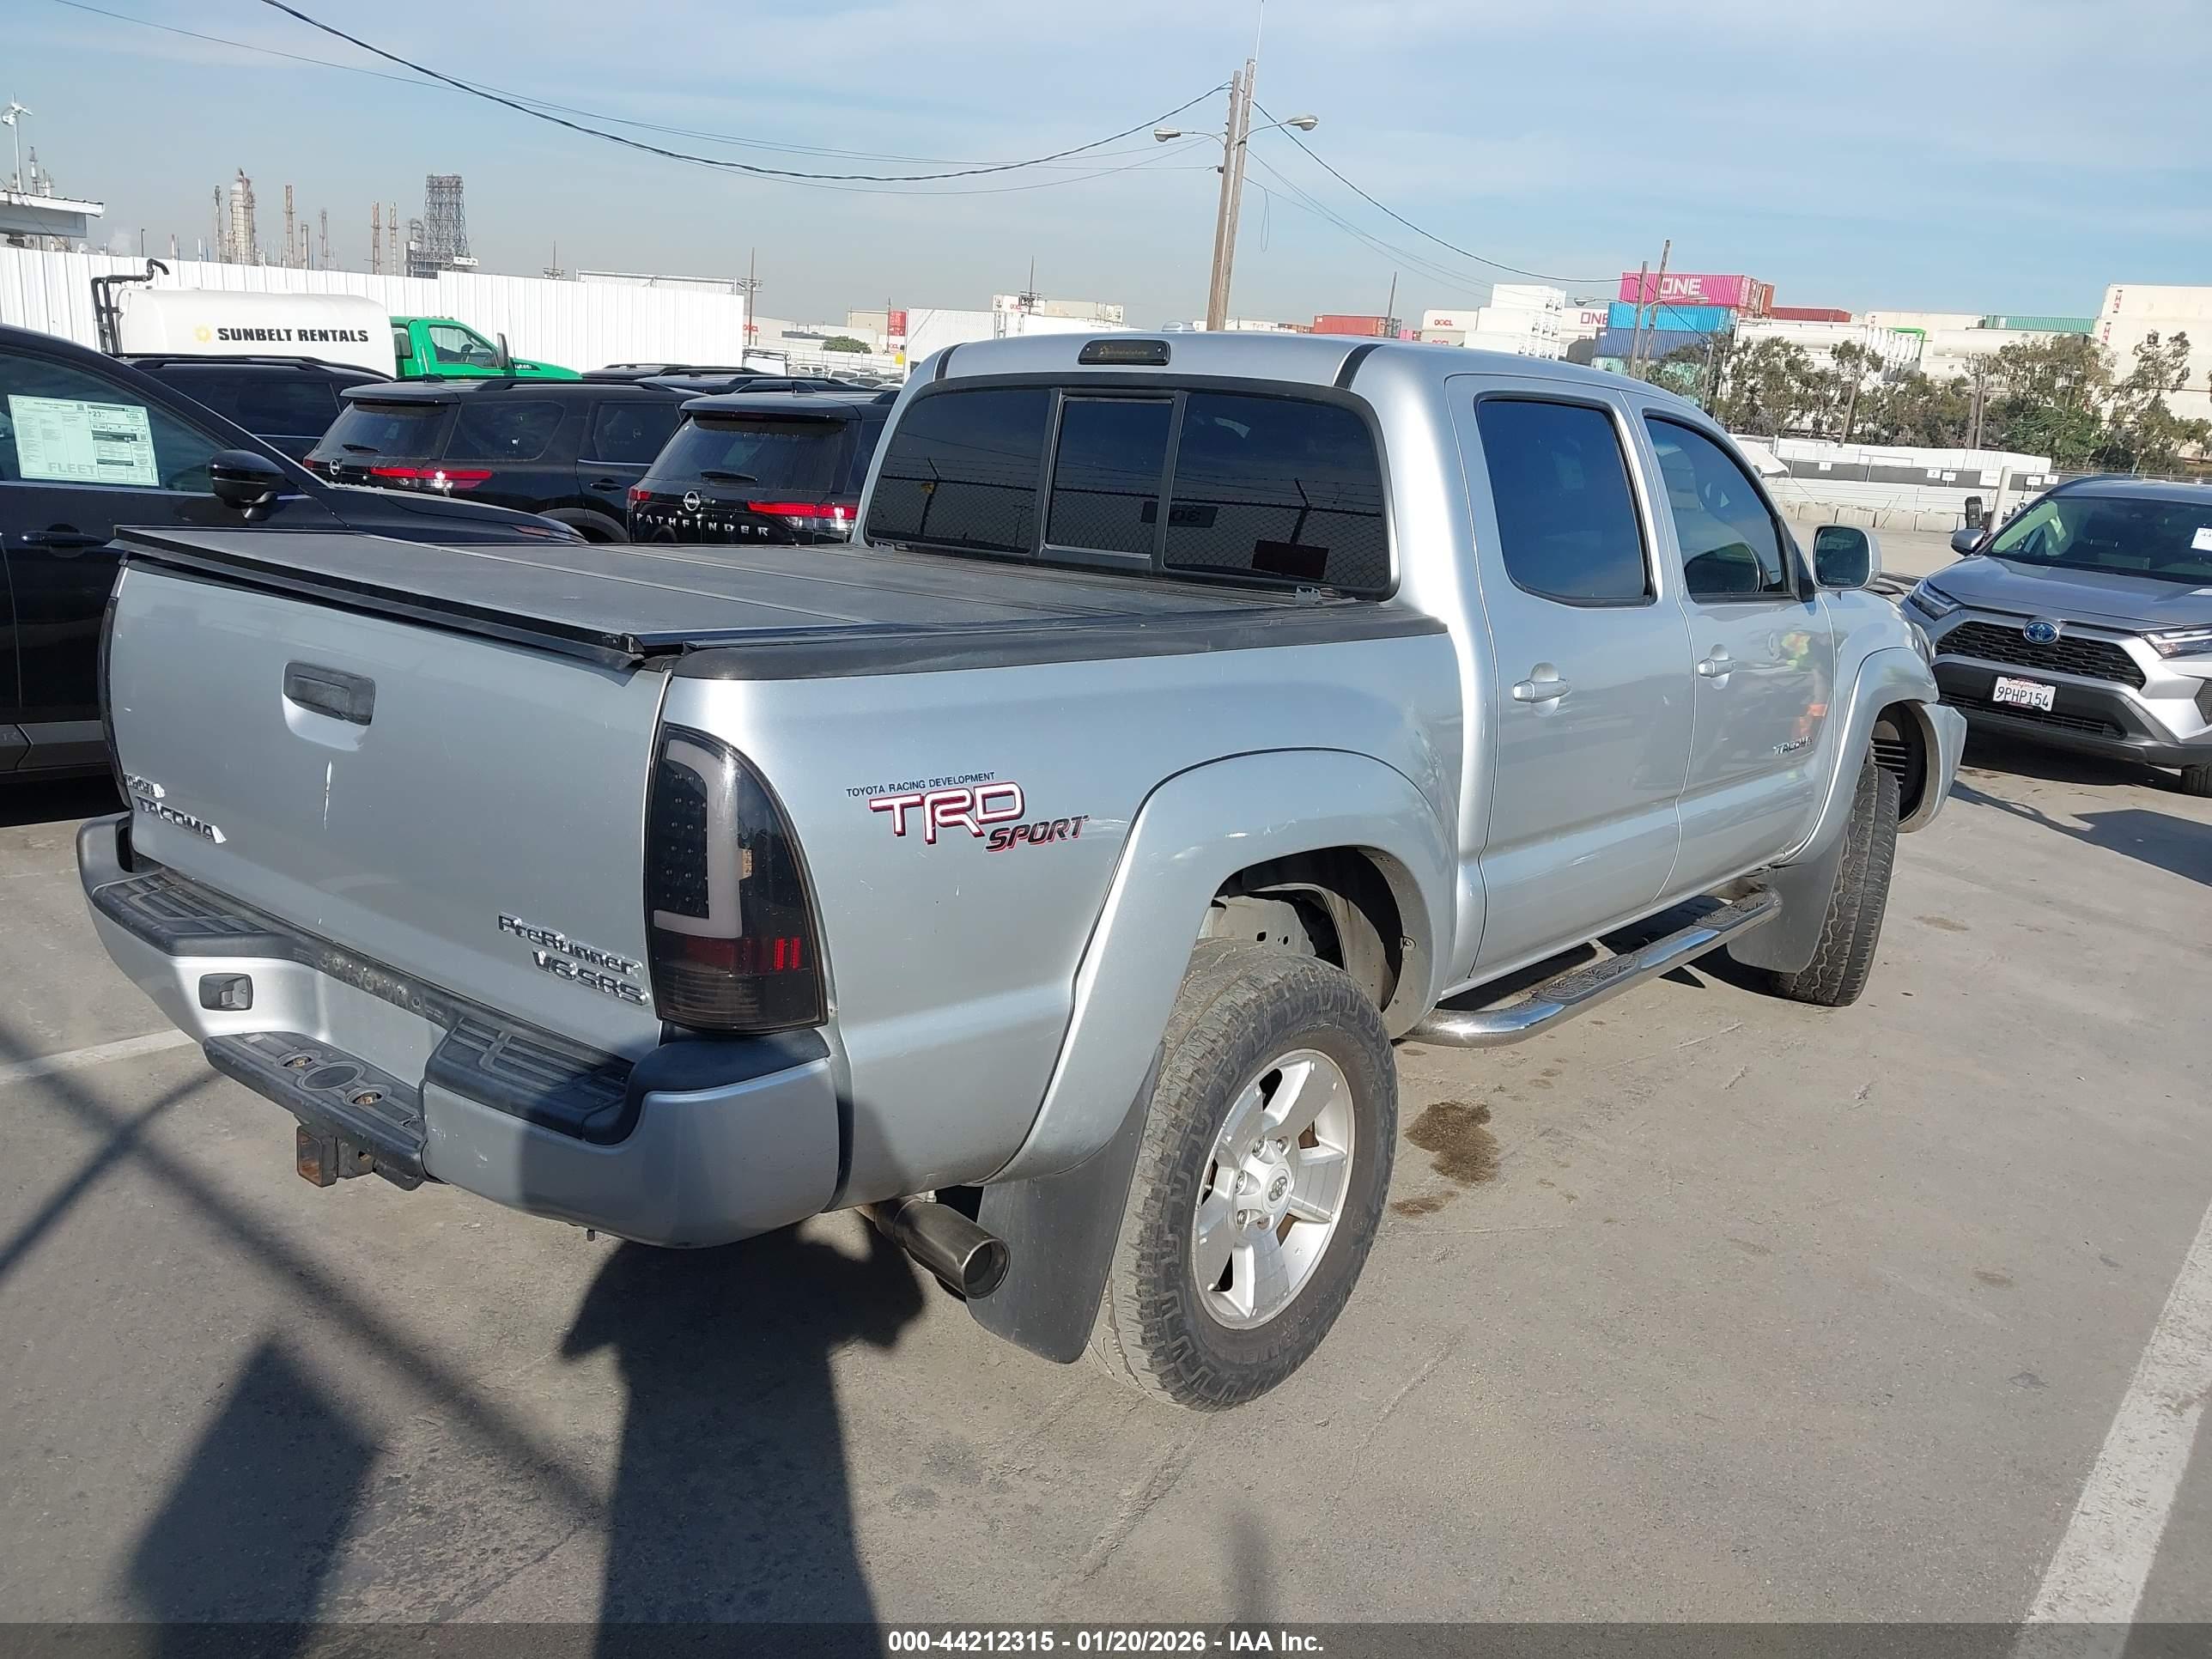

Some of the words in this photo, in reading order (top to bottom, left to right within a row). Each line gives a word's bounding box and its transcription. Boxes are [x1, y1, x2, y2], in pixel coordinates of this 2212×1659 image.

[1661, 277, 1702, 295] ONE
[217, 328, 292, 342] SUNBELT
[297, 329, 369, 343] RENTALS
[48, 462, 95, 474] FLEET
[636, 513, 769, 537] PATHFINDER
[1996, 686, 2049, 708] 9PHP154
[846, 785, 885, 798] TOYOTA
[889, 780, 926, 792] RACING
[928, 772, 994, 787] DEVELOPMENT
[869, 781, 1024, 845] TRD
[985, 815, 1090, 852] SPORT
